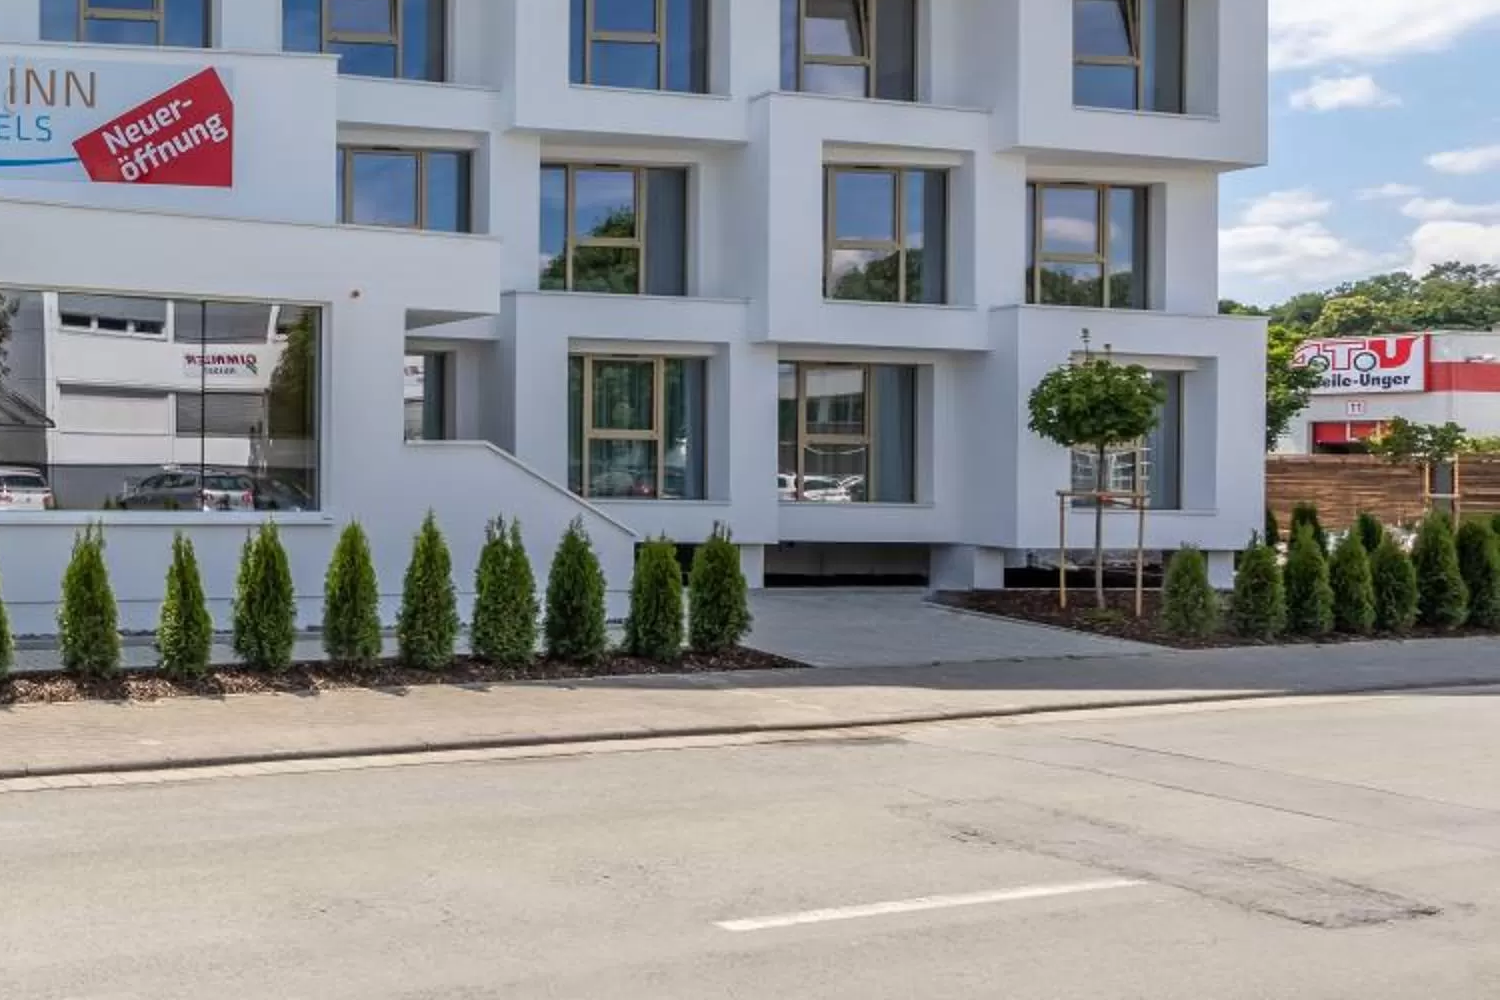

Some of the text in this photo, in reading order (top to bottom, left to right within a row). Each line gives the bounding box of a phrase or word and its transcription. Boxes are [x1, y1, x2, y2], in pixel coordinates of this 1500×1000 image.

[8, 65, 96, 109] INN
[102, 98, 193, 156] Neuer-
[117, 113, 229, 182] öffnung
